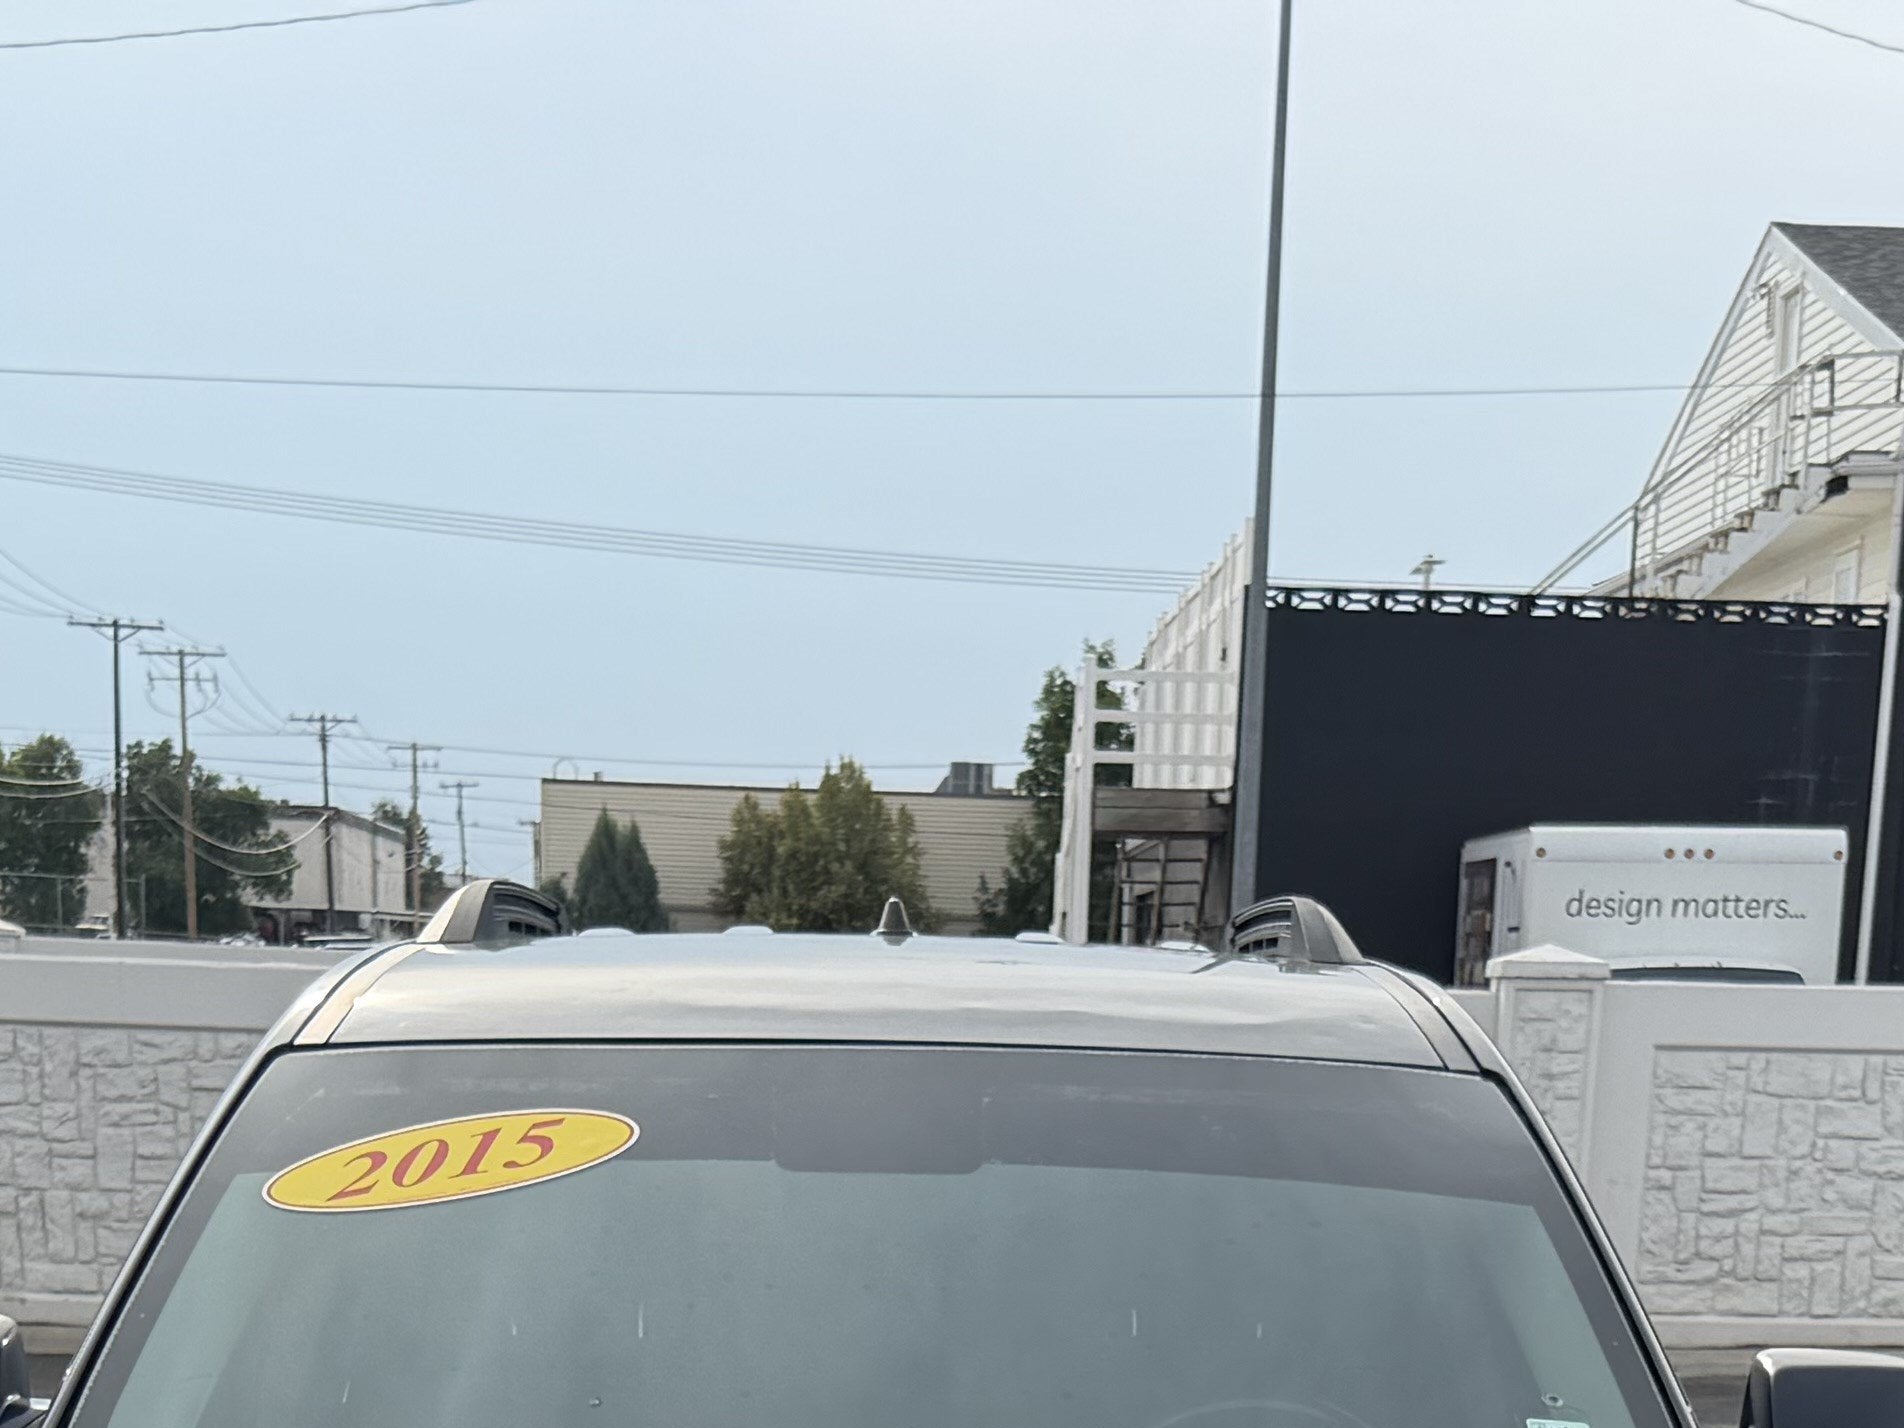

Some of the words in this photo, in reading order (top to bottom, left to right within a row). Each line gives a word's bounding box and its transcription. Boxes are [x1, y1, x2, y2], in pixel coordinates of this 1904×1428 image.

[1565, 888, 1663, 926] design
[1671, 893, 1807, 920] matters...
[325, 1117, 566, 1202] 2015
